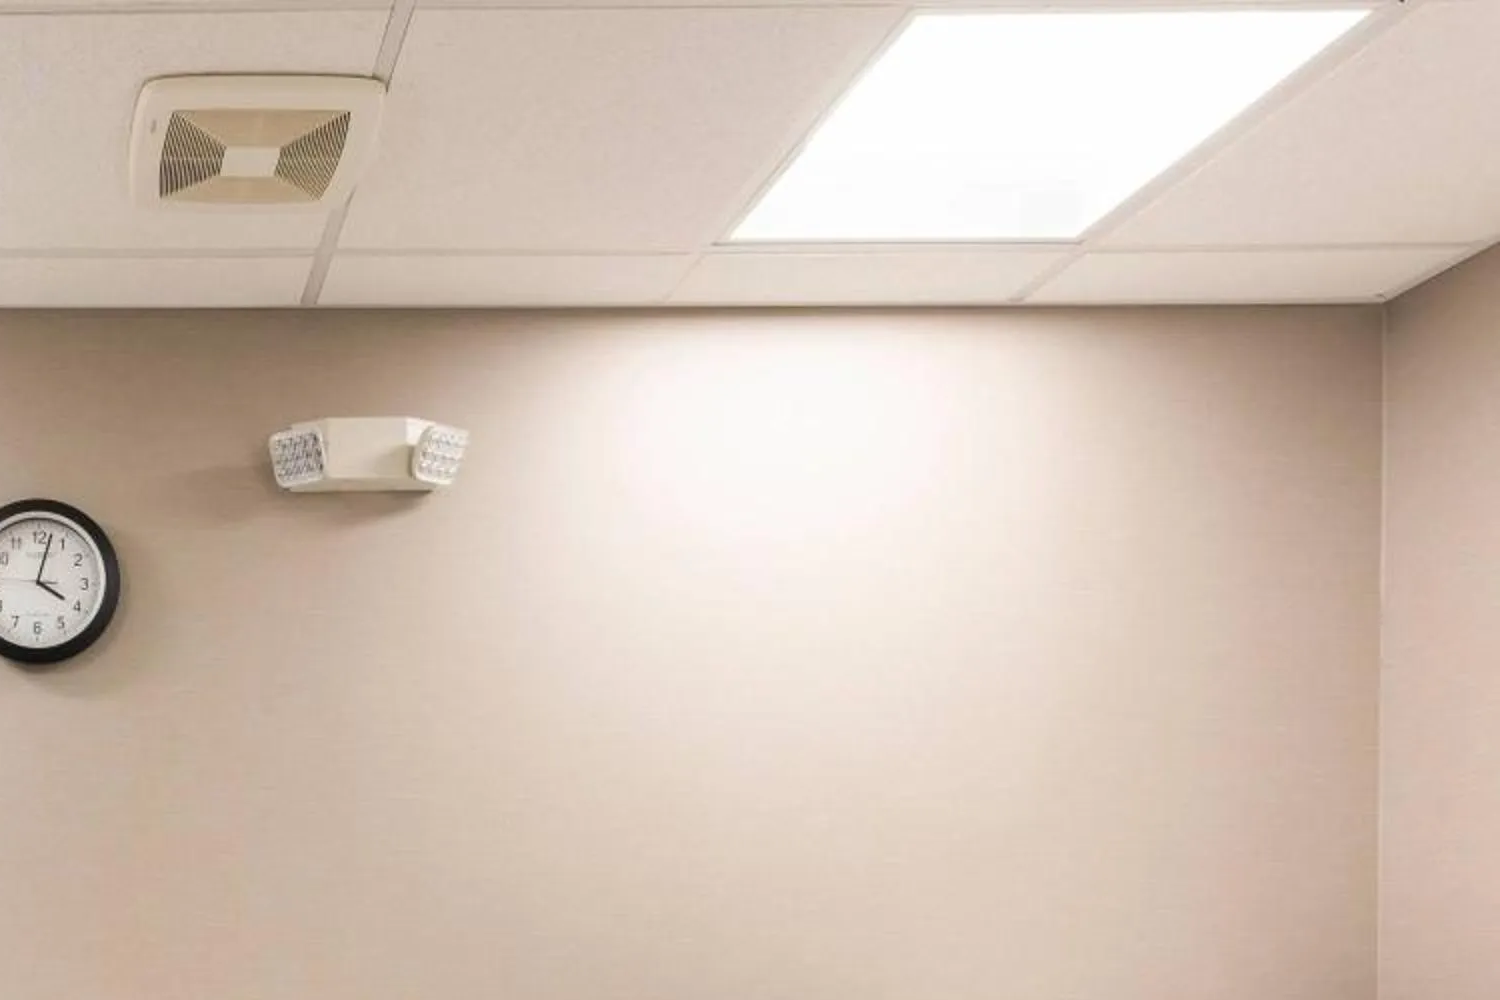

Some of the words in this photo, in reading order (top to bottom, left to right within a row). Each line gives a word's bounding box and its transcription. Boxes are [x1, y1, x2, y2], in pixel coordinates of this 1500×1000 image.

[11, 537, 22, 549] 11
[32, 530, 47, 545] 12
[73, 553, 83, 567] 2
[80, 578, 89, 590] 3
[73, 600, 81, 612] 4
[11, 616, 20, 628] 7
[33, 621, 42, 634] 6
[56, 616, 65, 629] 5
